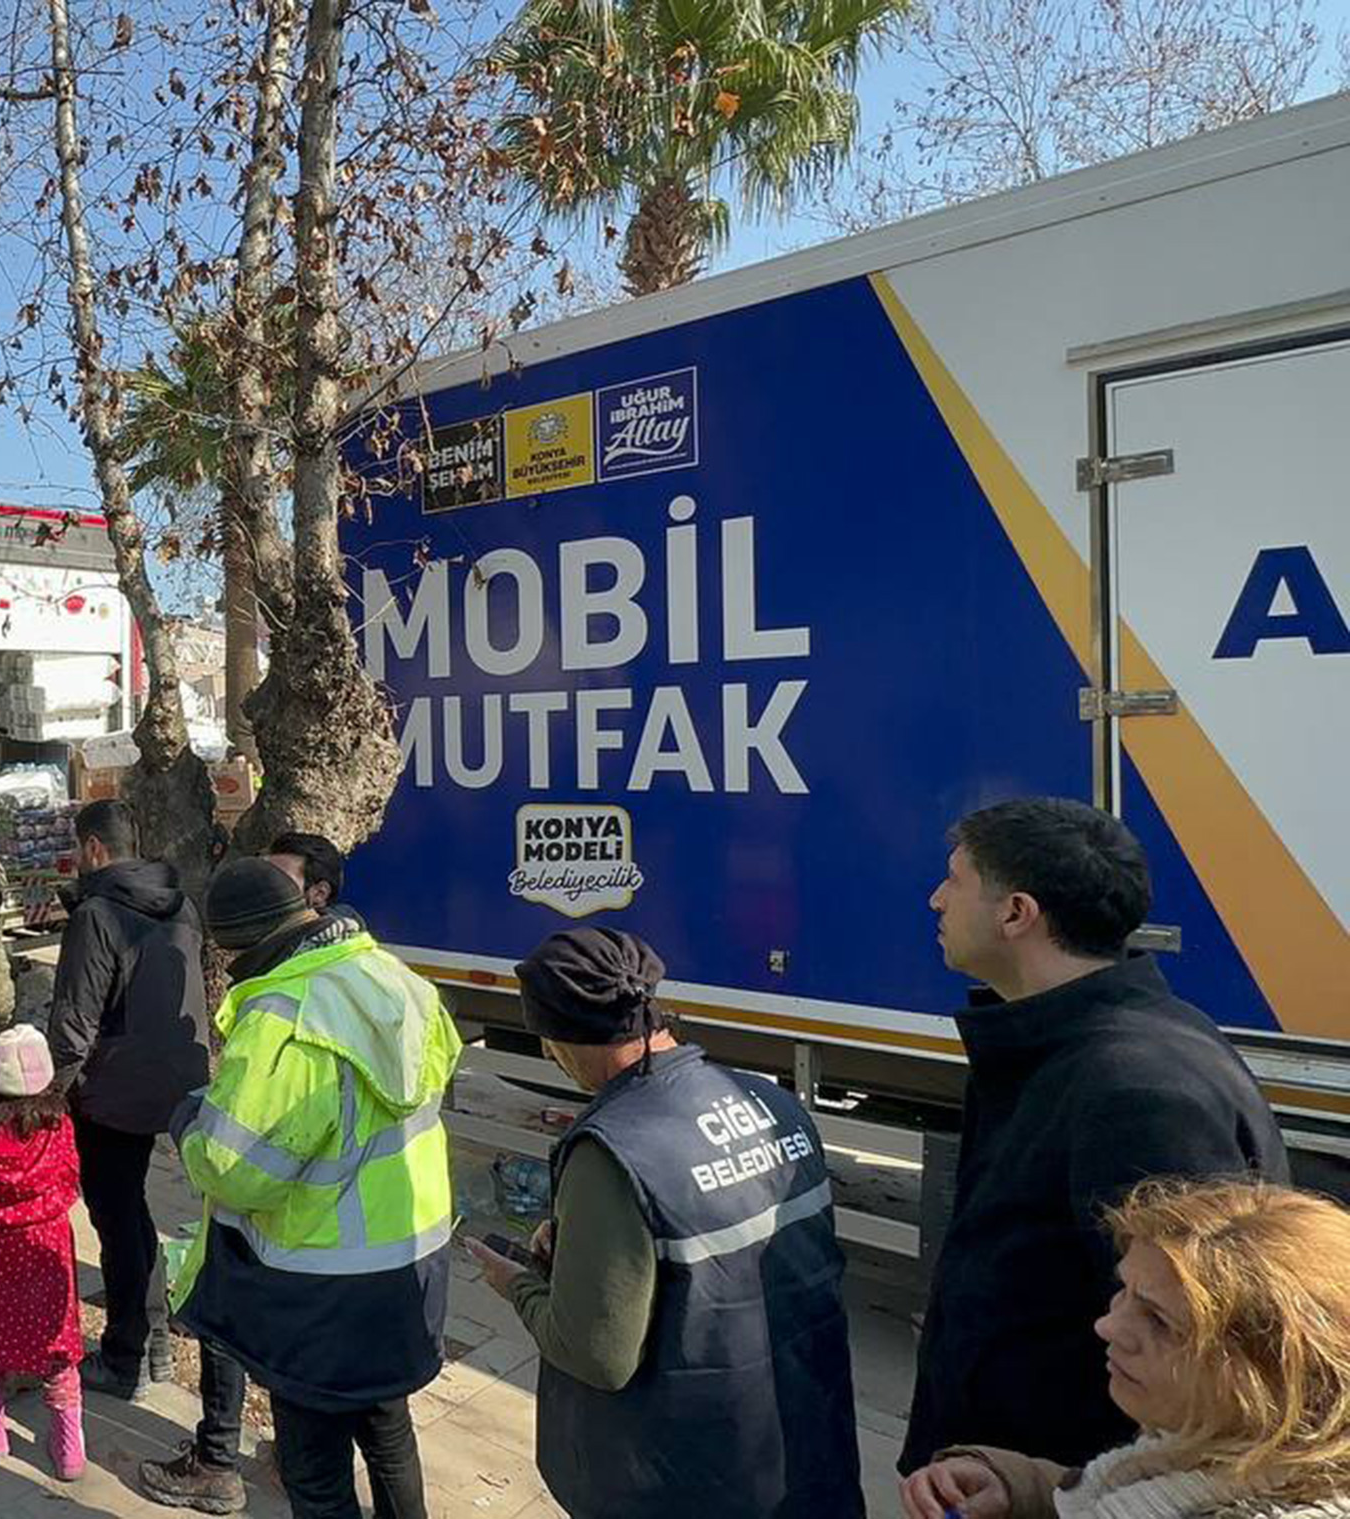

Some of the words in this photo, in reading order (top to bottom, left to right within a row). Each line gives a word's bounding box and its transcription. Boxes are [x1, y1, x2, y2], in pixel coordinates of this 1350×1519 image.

[621, 386, 671, 408] UĞUR
[428, 437, 493, 470] BENİM
[530, 446, 567, 461] KONYA
[604, 416, 690, 465] Altay
[362, 495, 810, 681] MOBİL
[1212, 545, 1350, 660] A
[399, 679, 810, 794] MUTFAK
[525, 816, 623, 840] KONYA
[524, 840, 623, 862] MODELİ
[513, 864, 642, 902] Belediyecilik
[696, 1089, 778, 1154] ÇİĞLİ
[691, 1125, 814, 1193] BELEDİYESİ
